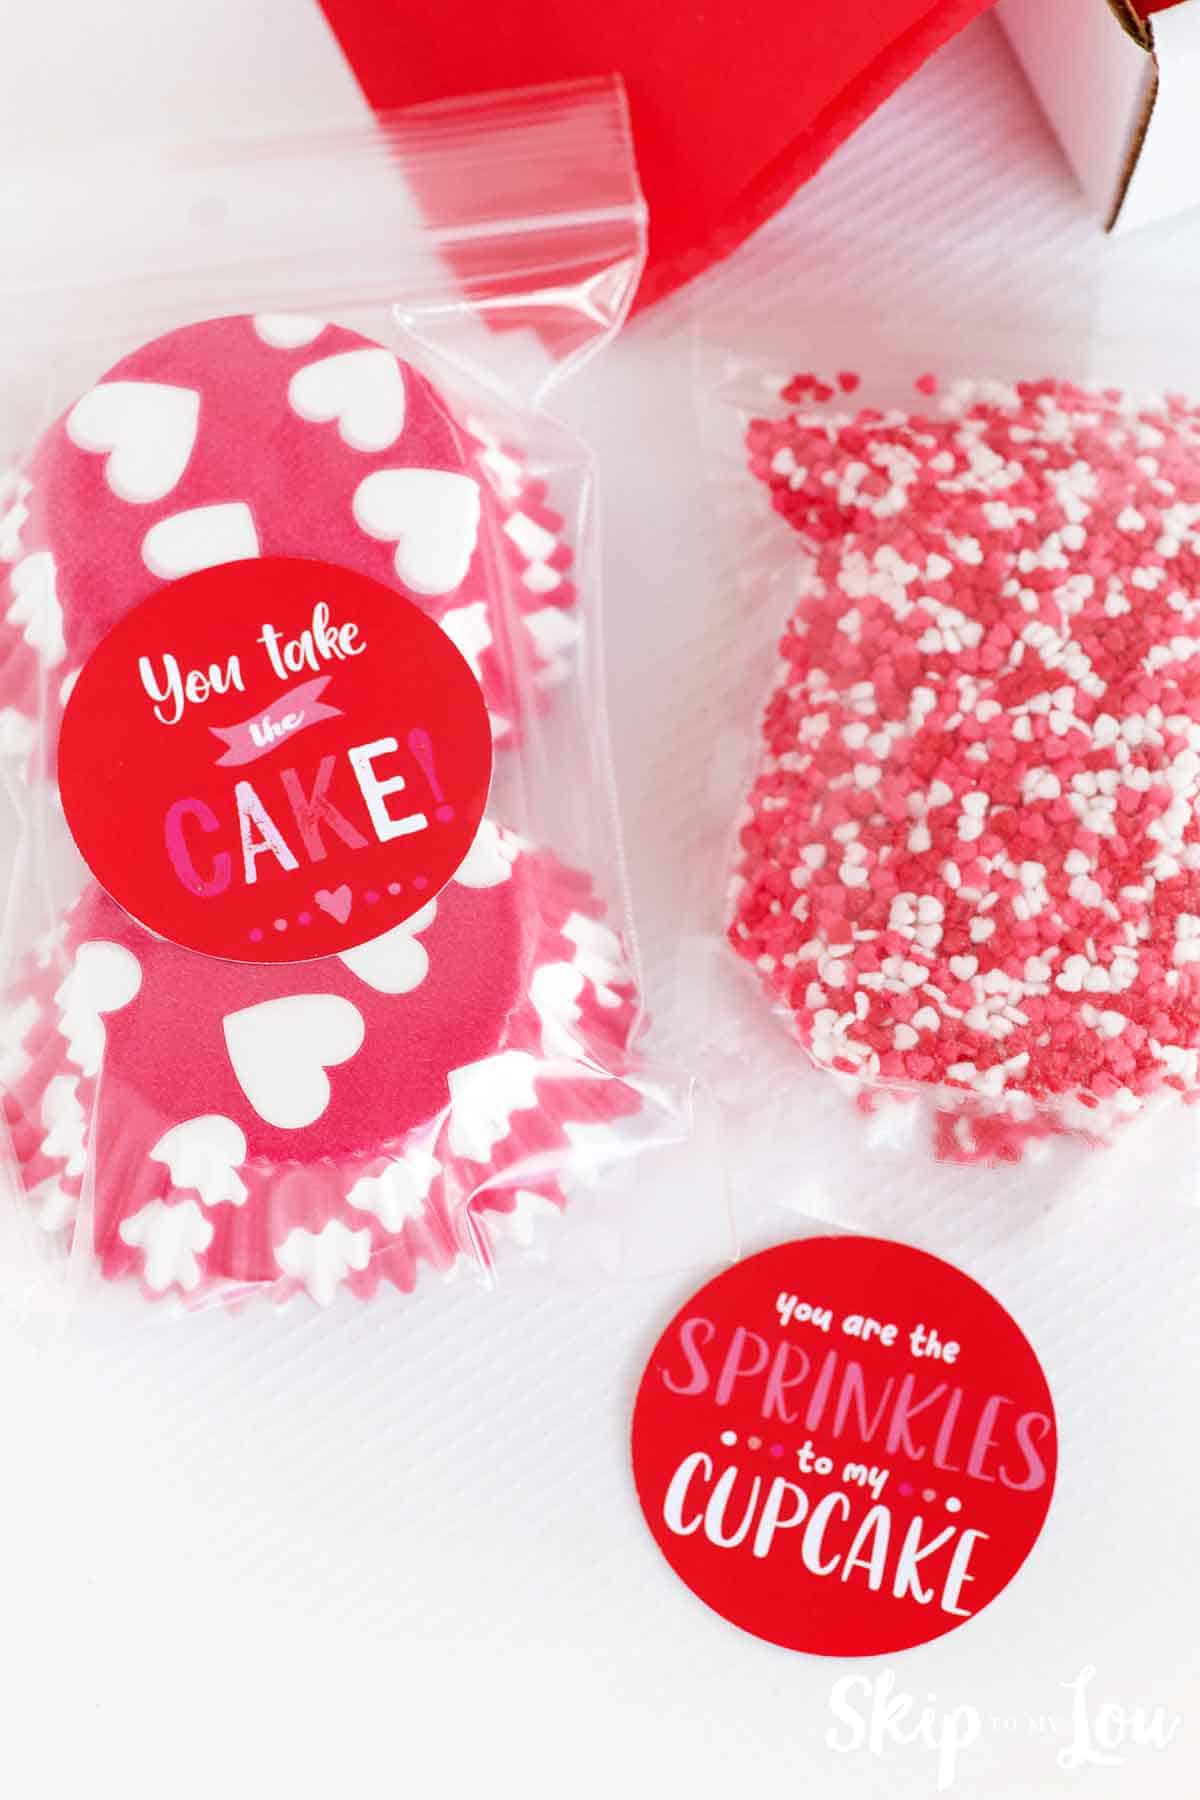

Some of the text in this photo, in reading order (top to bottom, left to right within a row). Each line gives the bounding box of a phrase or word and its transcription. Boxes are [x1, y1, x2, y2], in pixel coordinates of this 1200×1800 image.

[138, 601, 367, 725] You take
[248, 709, 305, 748] the
[163, 727, 455, 897] CAKE!
[775, 1291, 961, 1364] you are the
[661, 1317, 1052, 1492] SPRINKLES
[796, 1440, 889, 1500] to my
[663, 1451, 991, 1618] CUPCAKE
